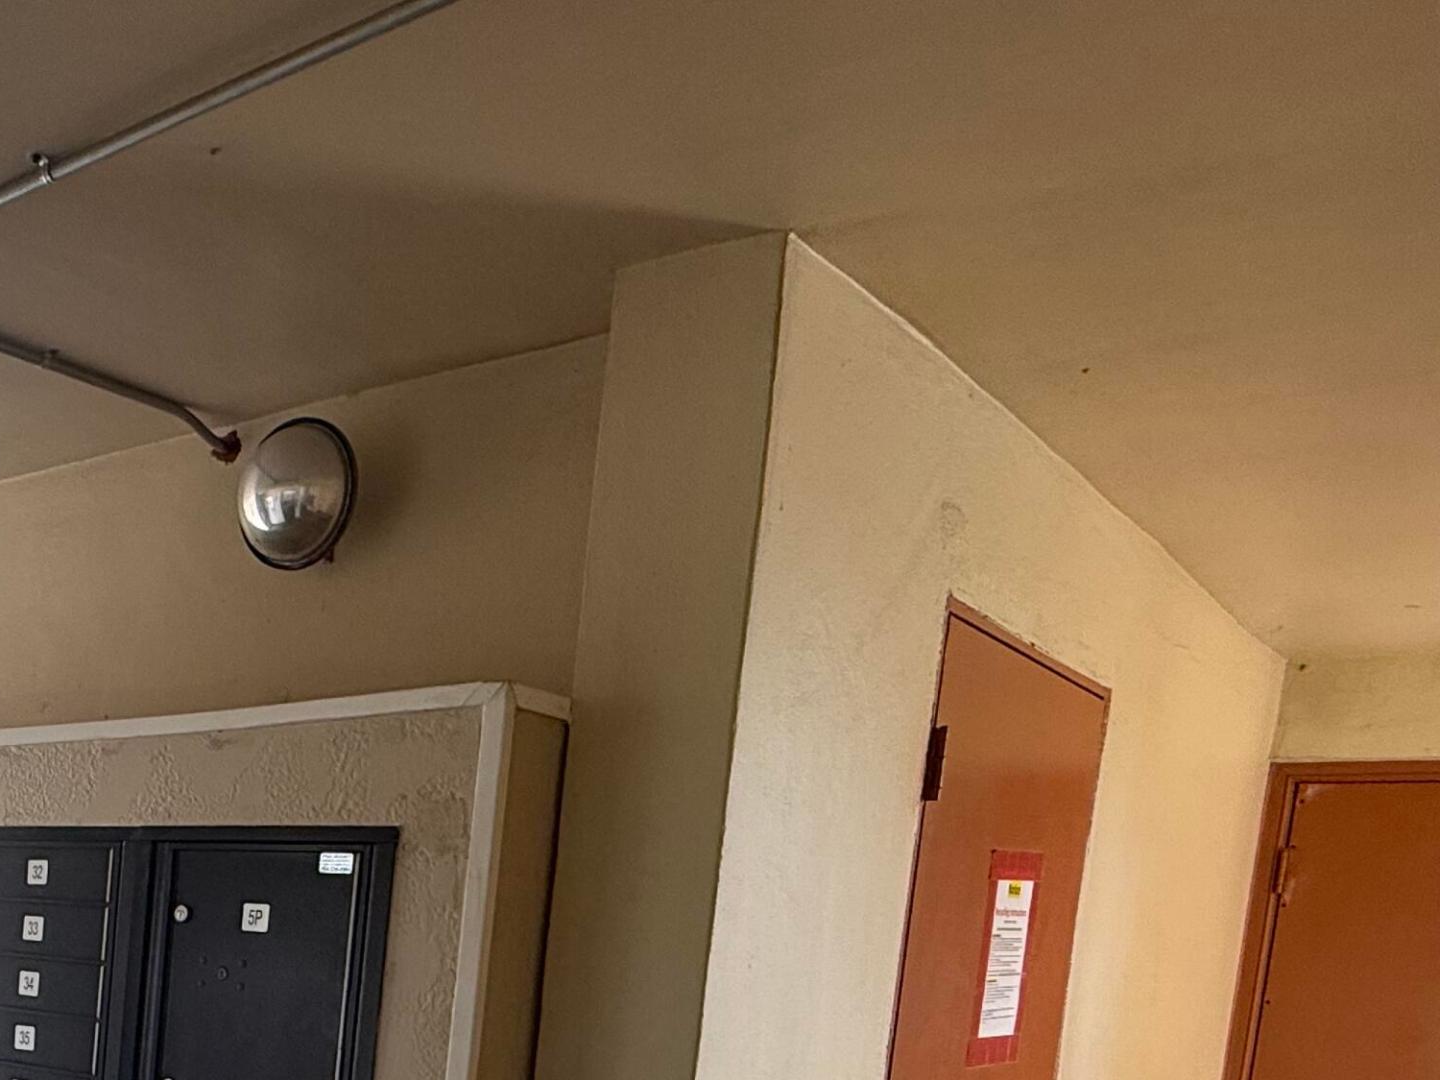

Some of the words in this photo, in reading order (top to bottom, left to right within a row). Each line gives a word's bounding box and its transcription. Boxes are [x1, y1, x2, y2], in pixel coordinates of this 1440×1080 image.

[31, 865, 44, 879] 32
[247, 910, 263, 925] 5P
[27, 921, 39, 935] 33
[23, 976, 34, 990] 34
[19, 1031, 31, 1045] 35
